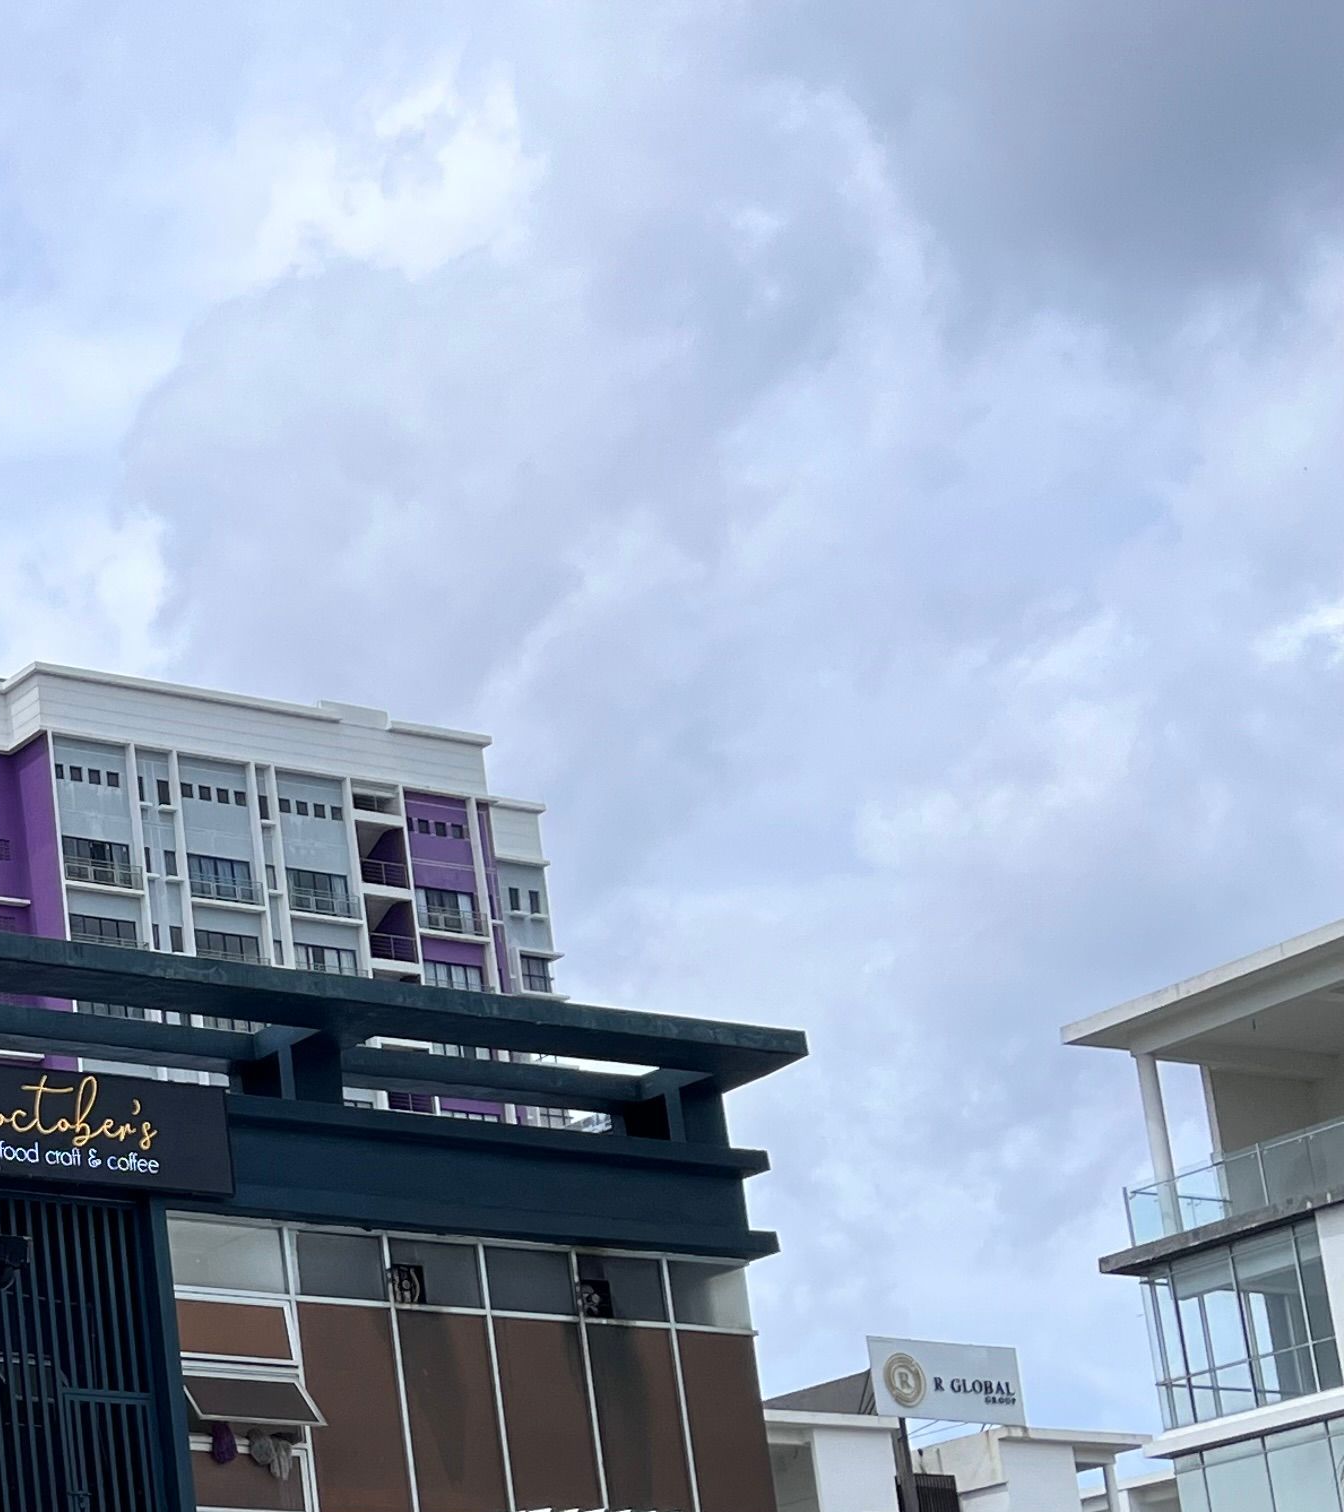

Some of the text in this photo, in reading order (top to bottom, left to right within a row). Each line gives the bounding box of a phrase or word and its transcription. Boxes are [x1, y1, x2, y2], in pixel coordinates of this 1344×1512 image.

[45, 1148, 81, 1168] craft
[88, 1149, 102, 1168] &
[107, 1154, 160, 1174] coffee
[933, 1376, 1016, 1396] R GLOBAL
[984, 1397, 1017, 1405] GROUP
